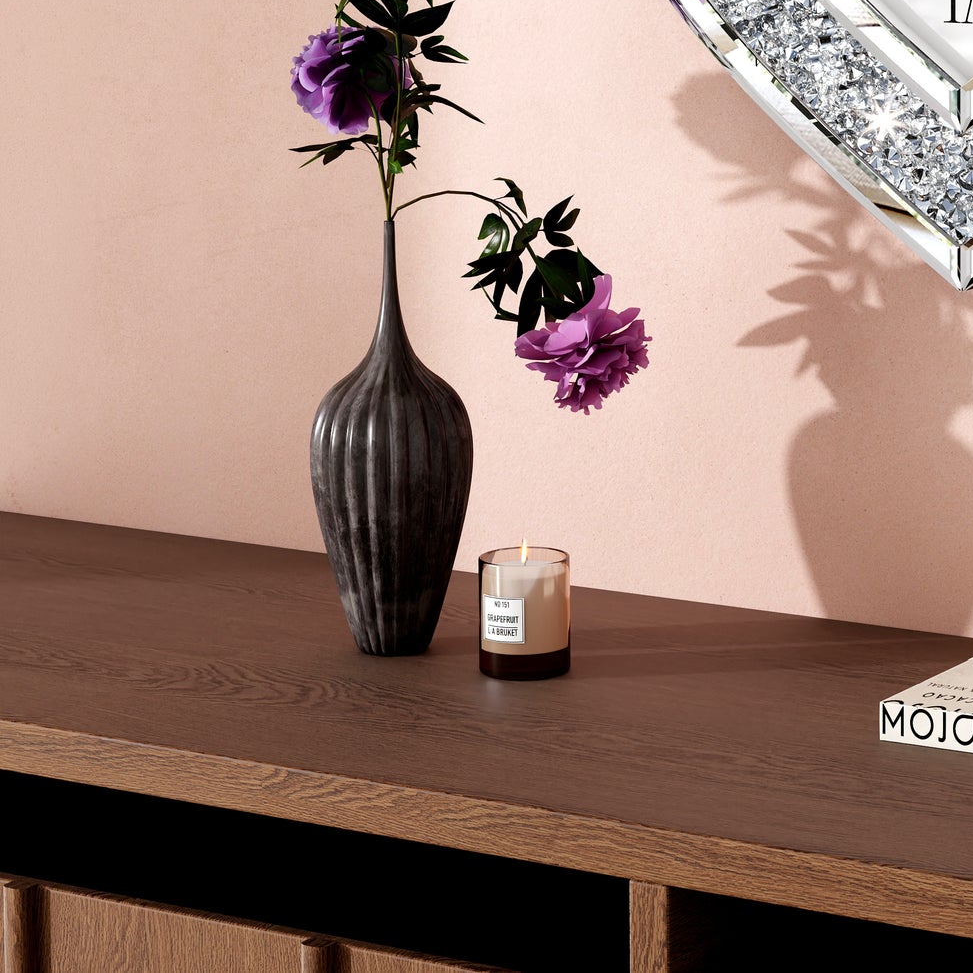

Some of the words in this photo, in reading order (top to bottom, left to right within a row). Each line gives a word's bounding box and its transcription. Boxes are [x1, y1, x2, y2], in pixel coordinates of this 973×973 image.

[487, 613, 519, 624] GRAPEFRUIT
[496, 628, 518, 637] BRUKET
[928, 682, 967, 692] NATURAL
